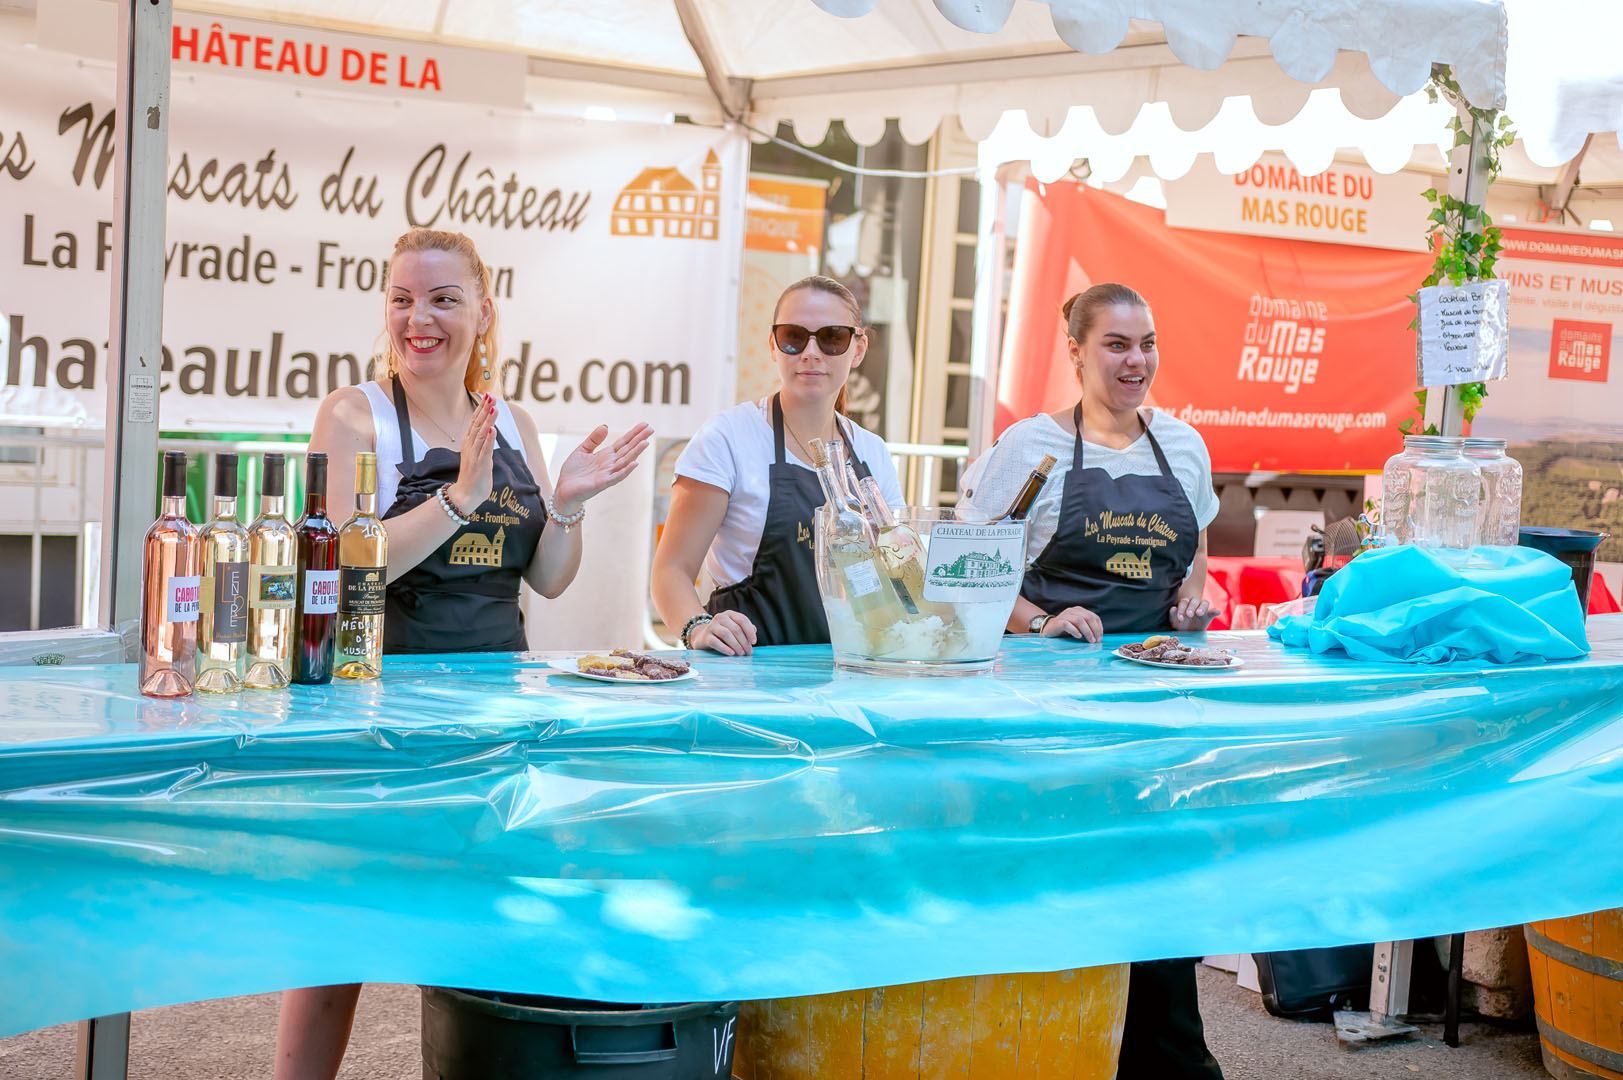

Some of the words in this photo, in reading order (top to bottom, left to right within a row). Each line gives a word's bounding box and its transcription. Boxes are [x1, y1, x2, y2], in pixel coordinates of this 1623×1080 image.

[171, 23, 328, 77] HÂTEAU
[340, 47, 387, 85] DE
[399, 55, 441, 91] LA
[57, 101, 299, 210] Mscats
[320, 143, 383, 219] du
[404, 142, 592, 232] Château
[1234, 163, 1337, 195] DOMAINE
[1342, 173, 1373, 200] DU
[1242, 197, 1289, 225] MAS
[1295, 202, 1367, 233] ROUGE
[22, 213, 79, 269] La
[95, 221, 278, 285] Pyrade
[1551, 275, 1576, 293] ET
[1249, 293, 1328, 321] domaine
[1236, 346, 1320, 394] Rouge
[485, 512, 520, 527] Frontignan
[796, 520, 811, 544] Les
[936, 527, 974, 537] CHATEAU
[975, 528, 986, 537] DE
[987, 528, 996, 537] LA
[1084, 516, 1099, 537] Les
[1099, 510, 1135, 530] Muscats
[1136, 511, 1147, 529] du
[1147, 513, 1178, 543] Château
[1096, 533, 1106, 543] La
[1106, 533, 1131, 545] Peyrade
[1135, 535, 1167, 548] Frontignan
[174, 601, 185, 613] DE
[185, 601, 194, 613] LA
[311, 594, 320, 605] DE
[320, 594, 329, 605] LA
